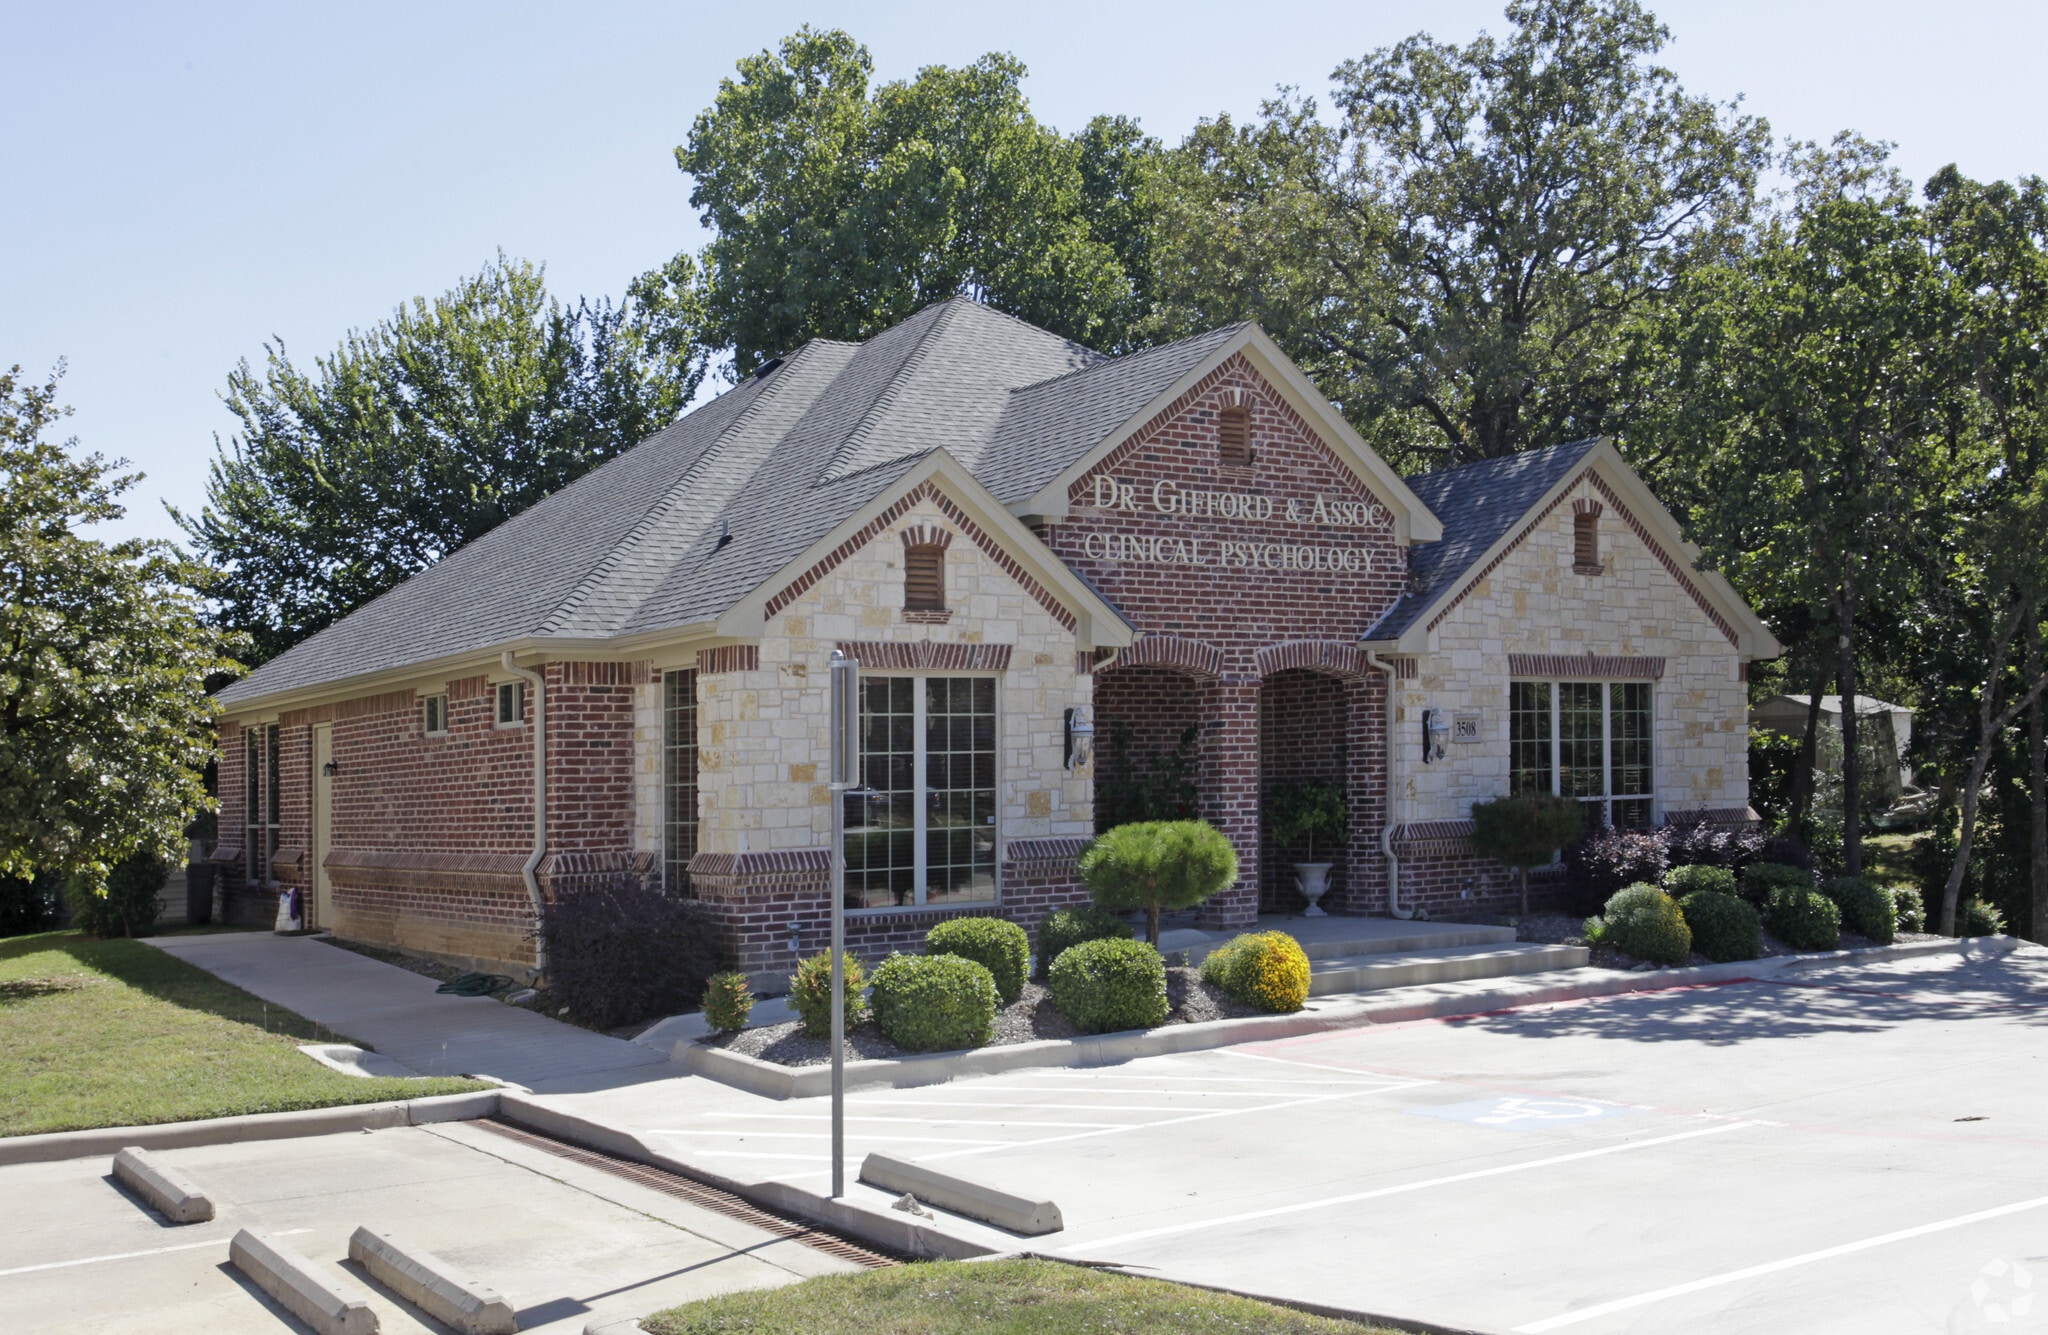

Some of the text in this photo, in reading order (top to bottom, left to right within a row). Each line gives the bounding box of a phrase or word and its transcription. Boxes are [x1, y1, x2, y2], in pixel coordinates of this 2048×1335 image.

[1092, 474, 1388, 527] DR. GIFFORD & ASSOC.
[1085, 533, 1377, 572] CLINICAL PSYCHOLOGY
[1456, 721, 1477, 737] 3508
